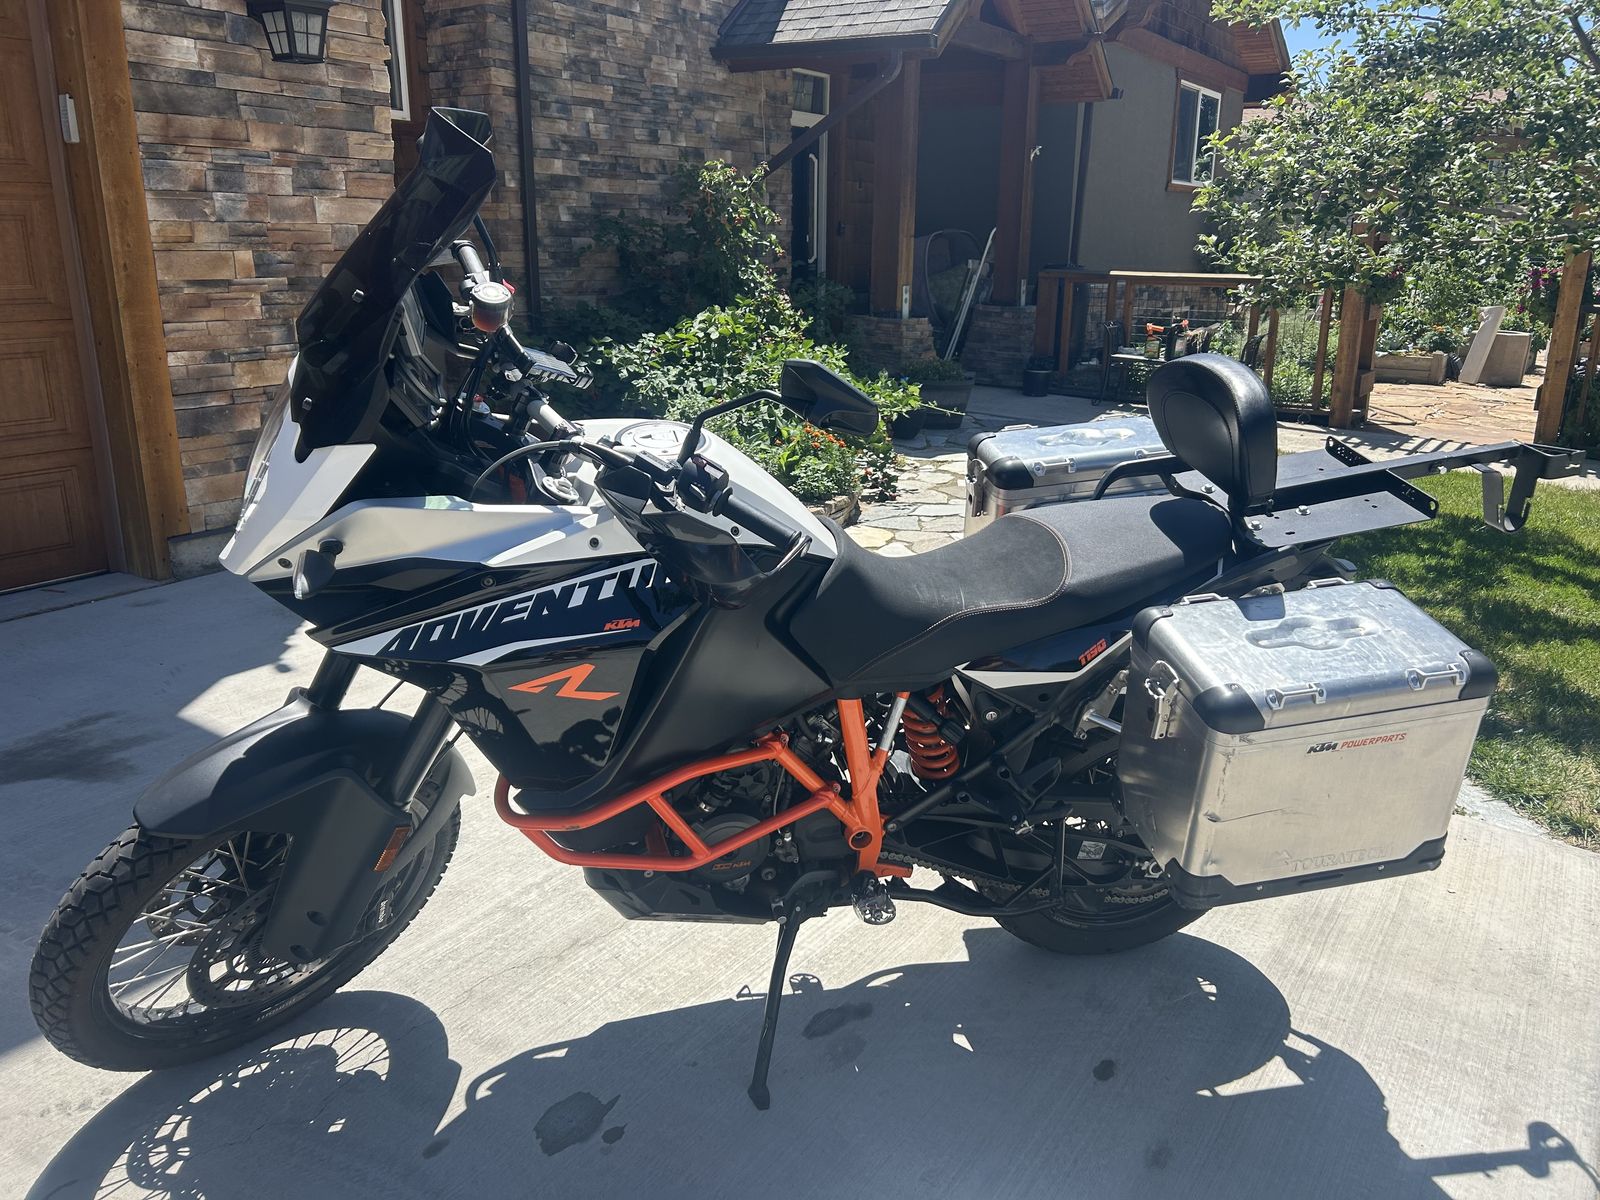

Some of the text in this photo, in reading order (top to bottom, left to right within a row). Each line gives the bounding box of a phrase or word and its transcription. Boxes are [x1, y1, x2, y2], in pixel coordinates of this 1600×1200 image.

[374, 561, 671, 655] ADVENTU
[603, 618, 641, 631] KTM
[1306, 732, 1407, 754] KTM POWERPARTS
